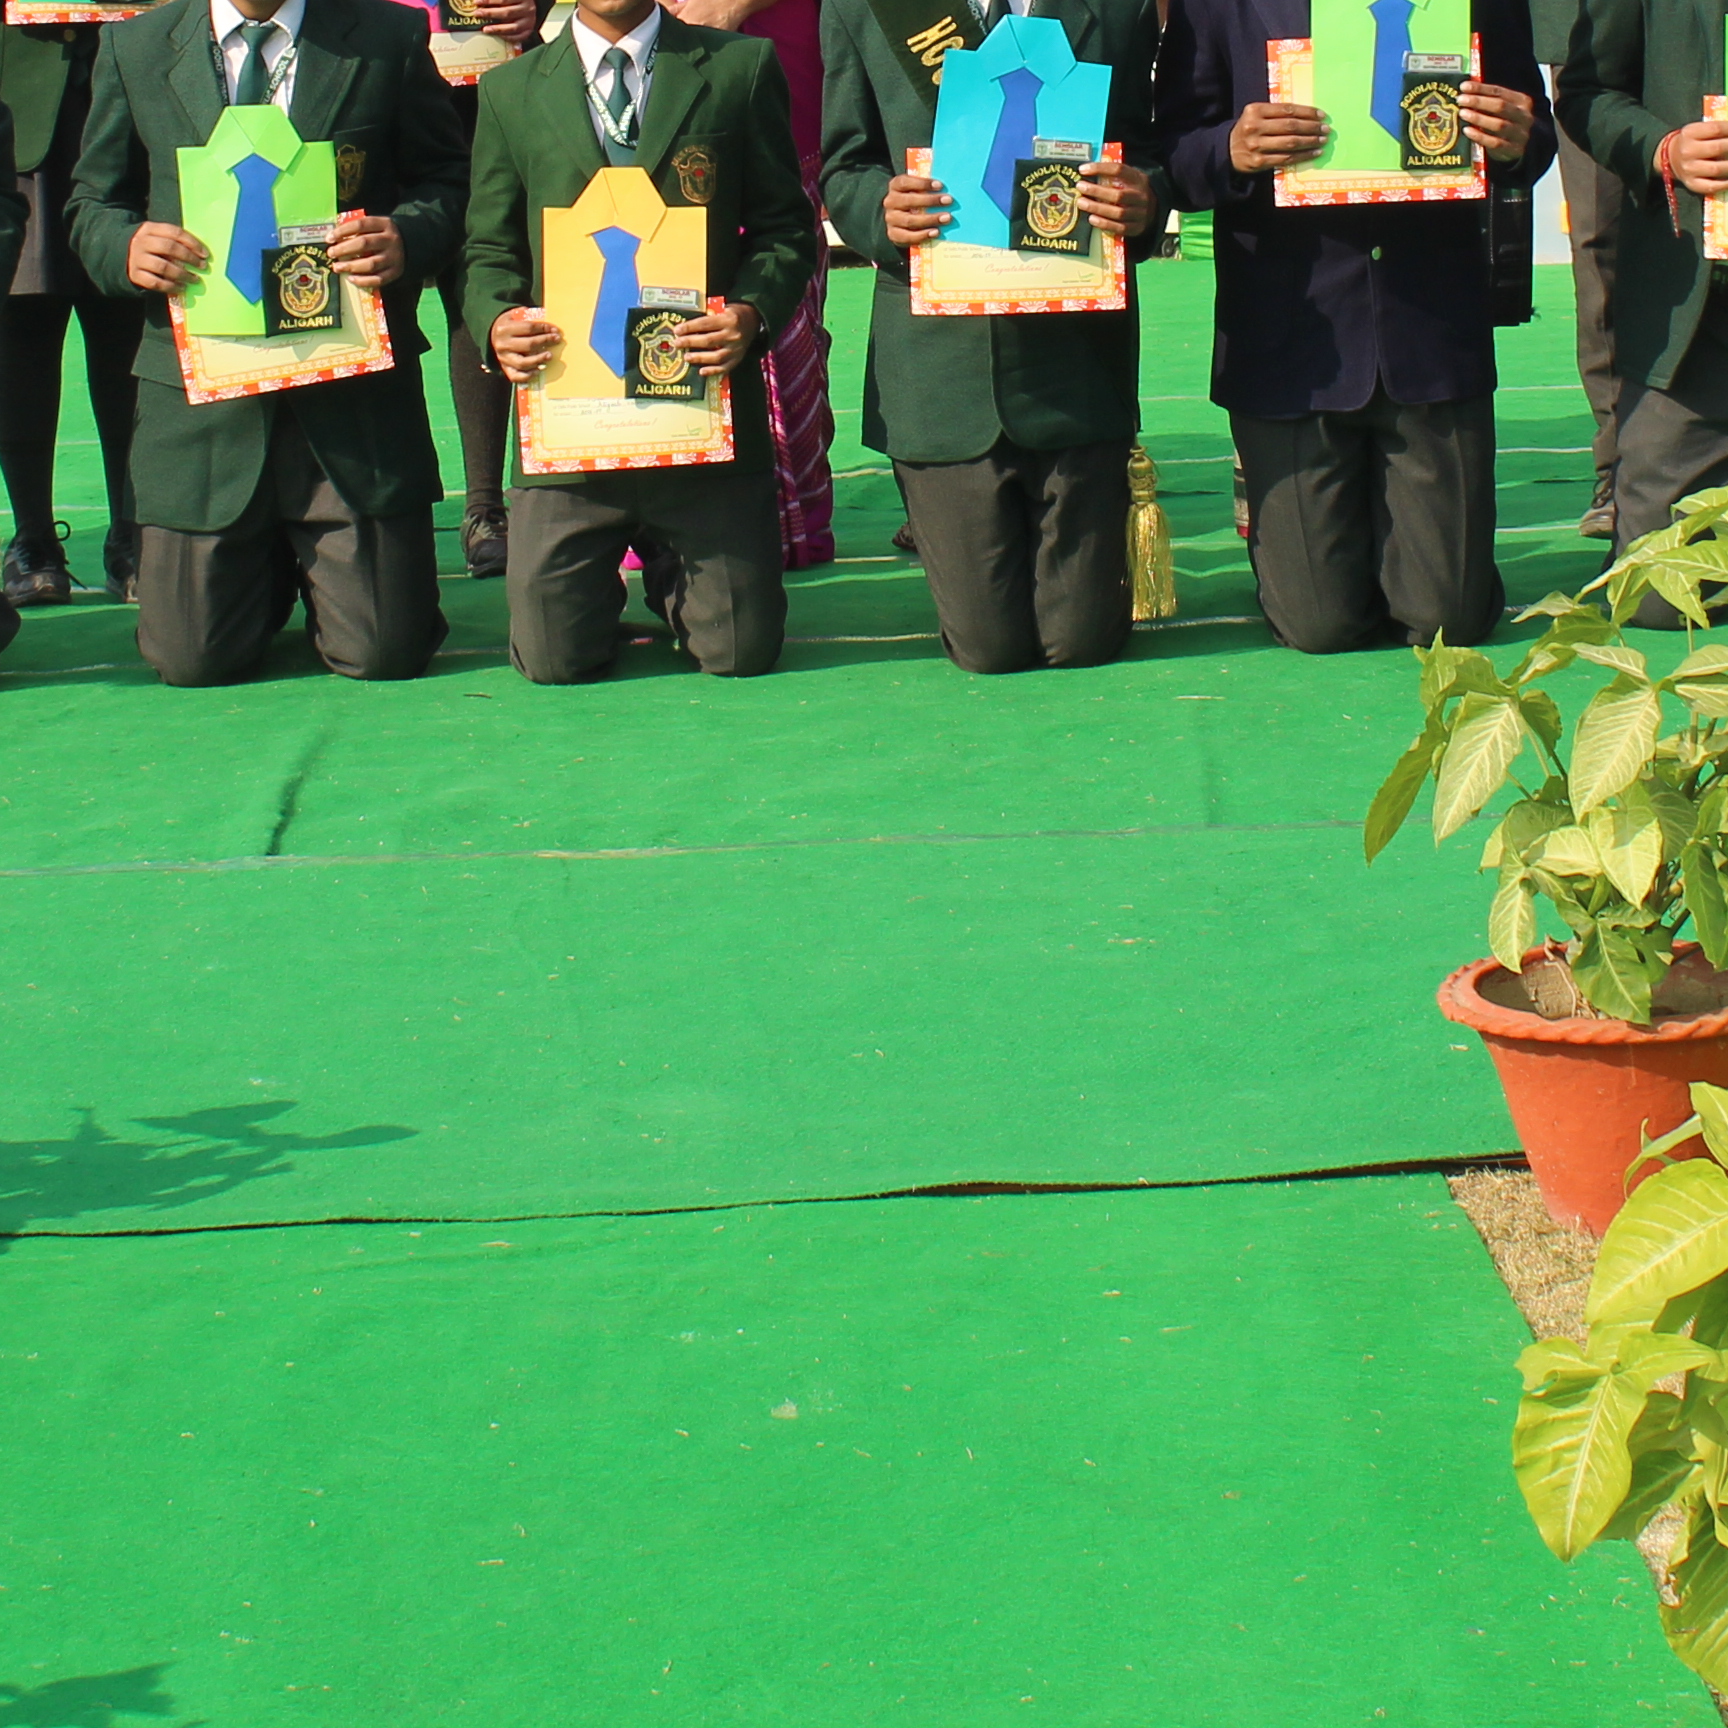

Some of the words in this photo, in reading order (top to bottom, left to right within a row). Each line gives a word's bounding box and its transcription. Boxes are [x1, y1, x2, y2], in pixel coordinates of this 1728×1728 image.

[270, 58, 290, 90] SCHOOL
[1400, 82, 1438, 109] SCHOLAR
[1438, 83, 1459, 99] 2016
[1407, 154, 1461, 166] ALIGARH
[1020, 164, 1062, 188] SCHOLAR
[1062, 166, 1082, 182] 2016
[1020, 234, 1079, 251] ALIGARH
[271, 245, 306, 274] SCHOLAR
[279, 315, 334, 329] ALIGARH
[632, 311, 669, 337] SCHOLAR
[635, 383, 692, 396] ALIGARH
